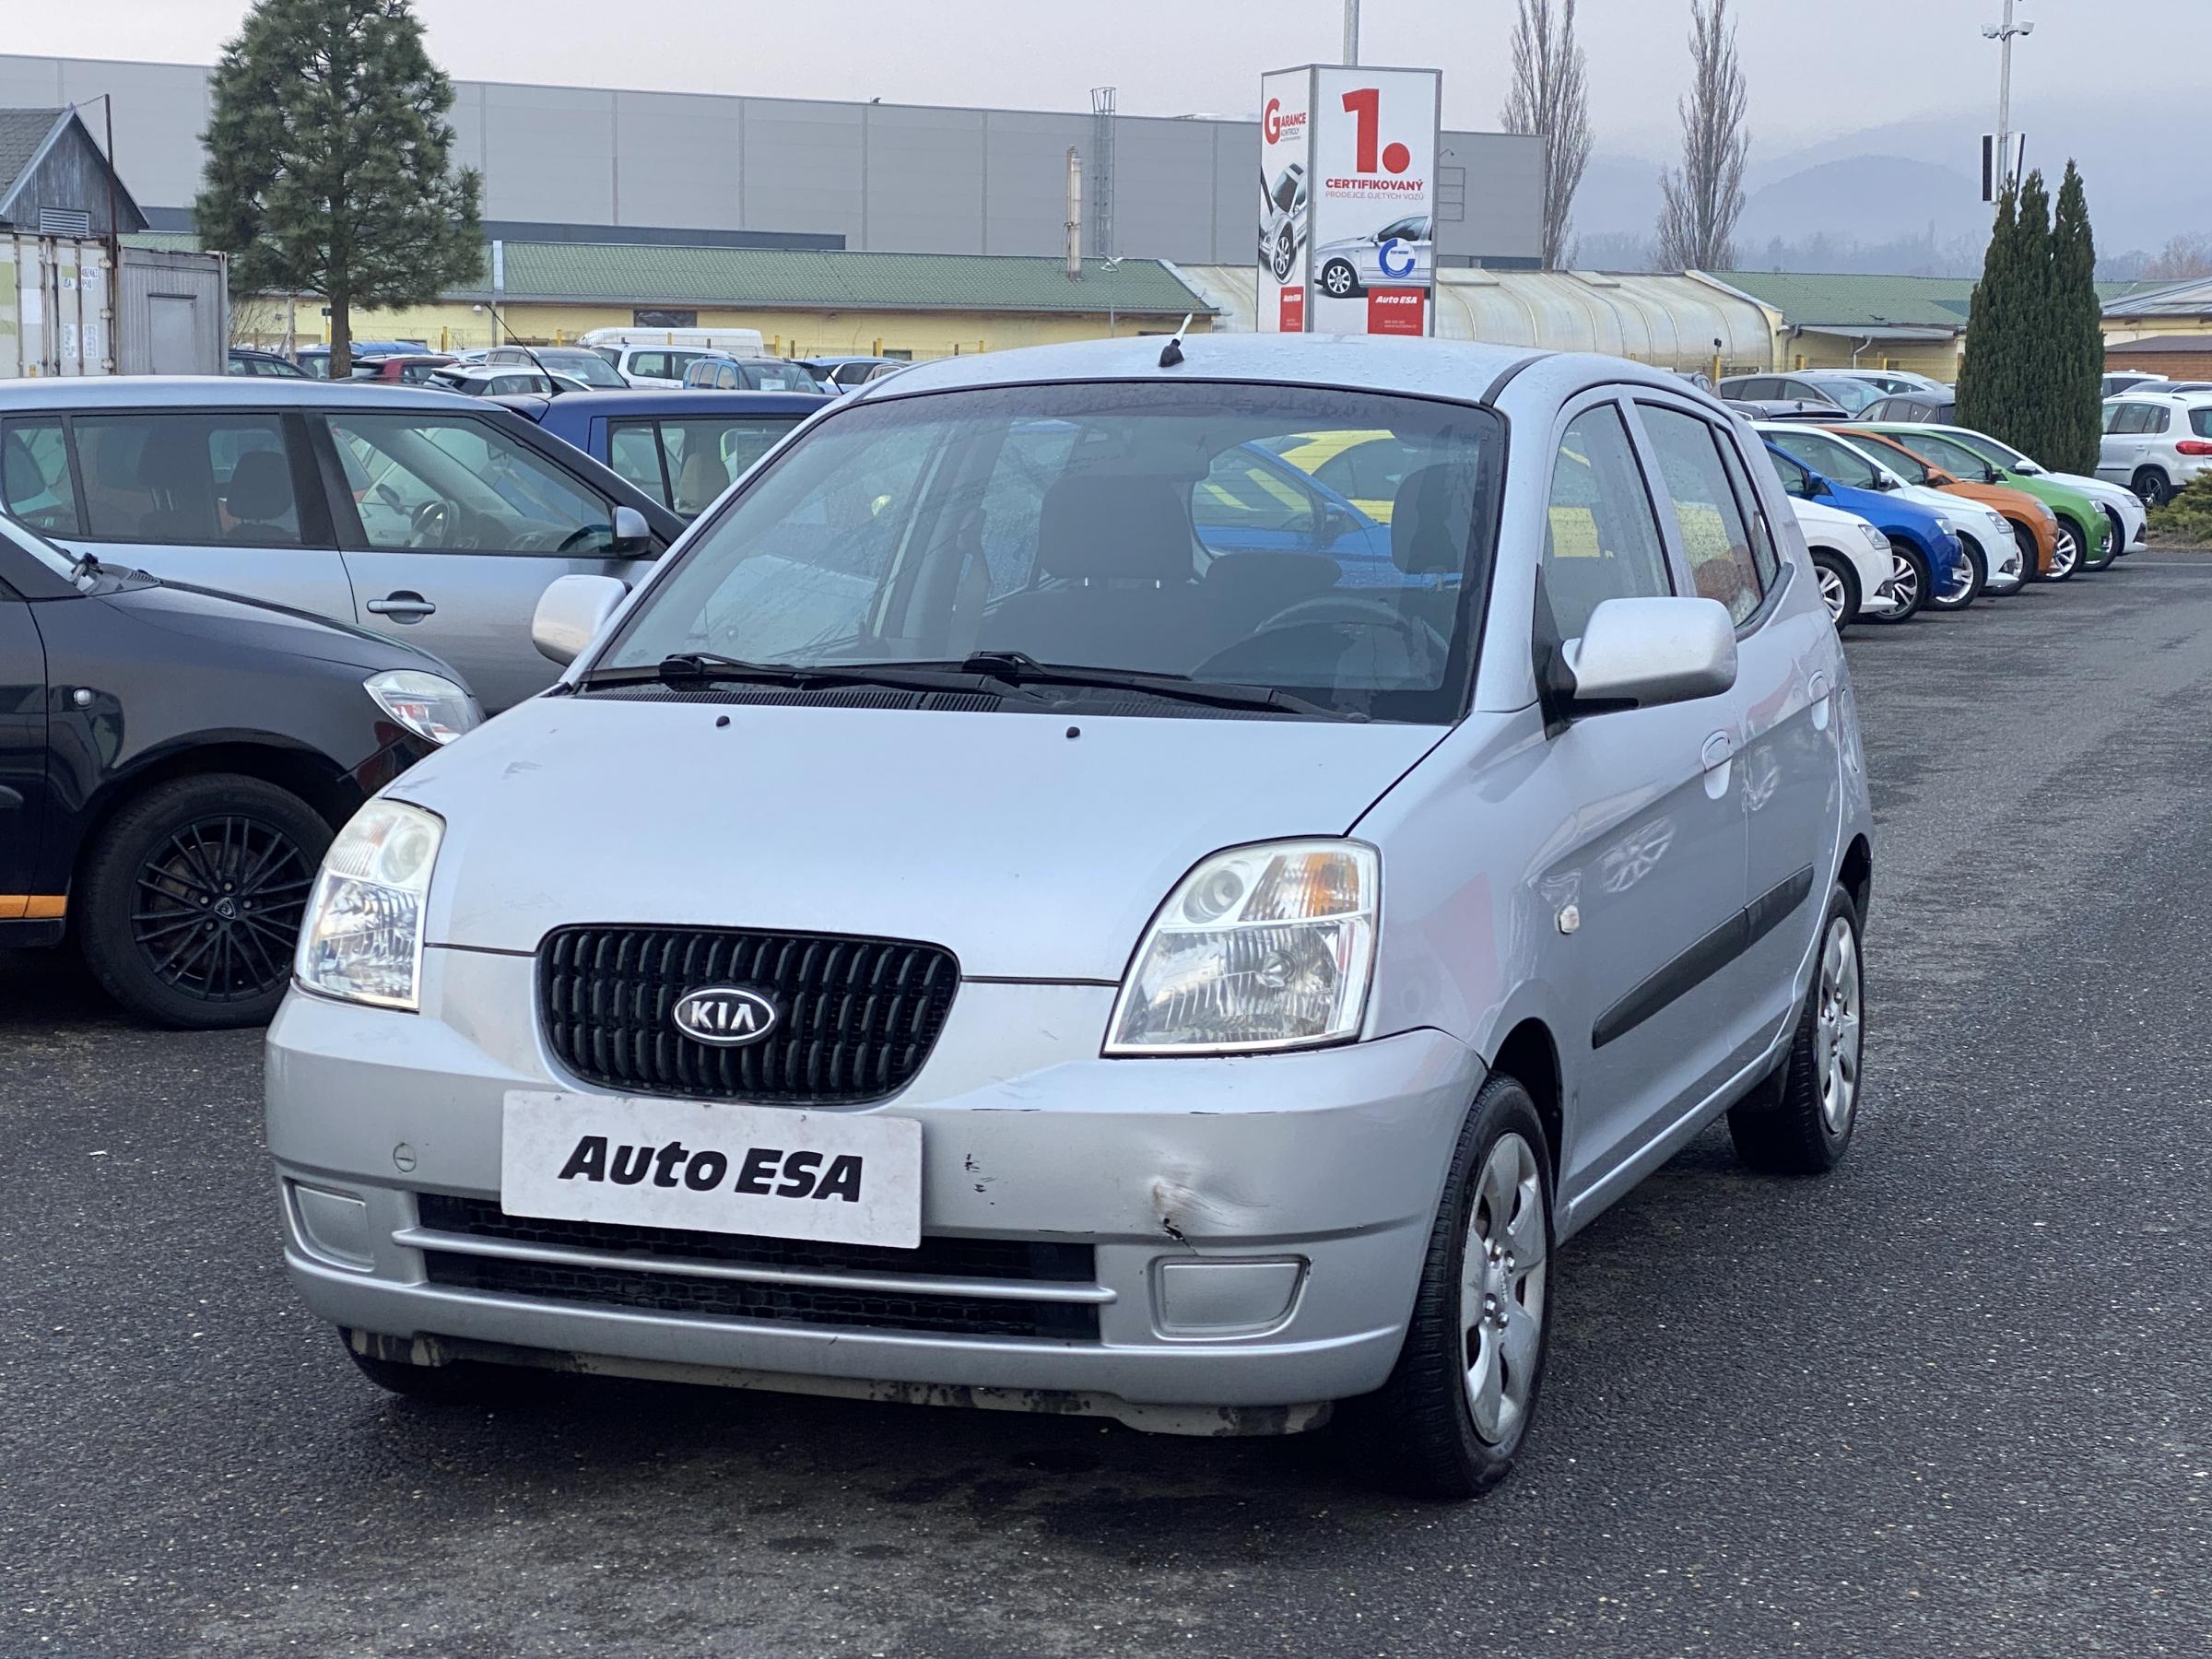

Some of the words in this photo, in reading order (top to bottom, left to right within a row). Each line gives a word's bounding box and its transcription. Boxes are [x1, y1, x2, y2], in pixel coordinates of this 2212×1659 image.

[1325, 178, 1424, 191] CERTIFIKOVANÝ
[1325, 191, 1366, 199] PRODEJCE
[1367, 191, 1402, 200] OJETÝCH
[1403, 192, 1424, 201] VOZŮ
[1375, 296, 1399, 304] Auto
[1399, 296, 1418, 304] ESA
[691, 1000, 756, 1031] KIA
[558, 1135, 728, 1192] Auto
[734, 1147, 864, 1203] ESA
